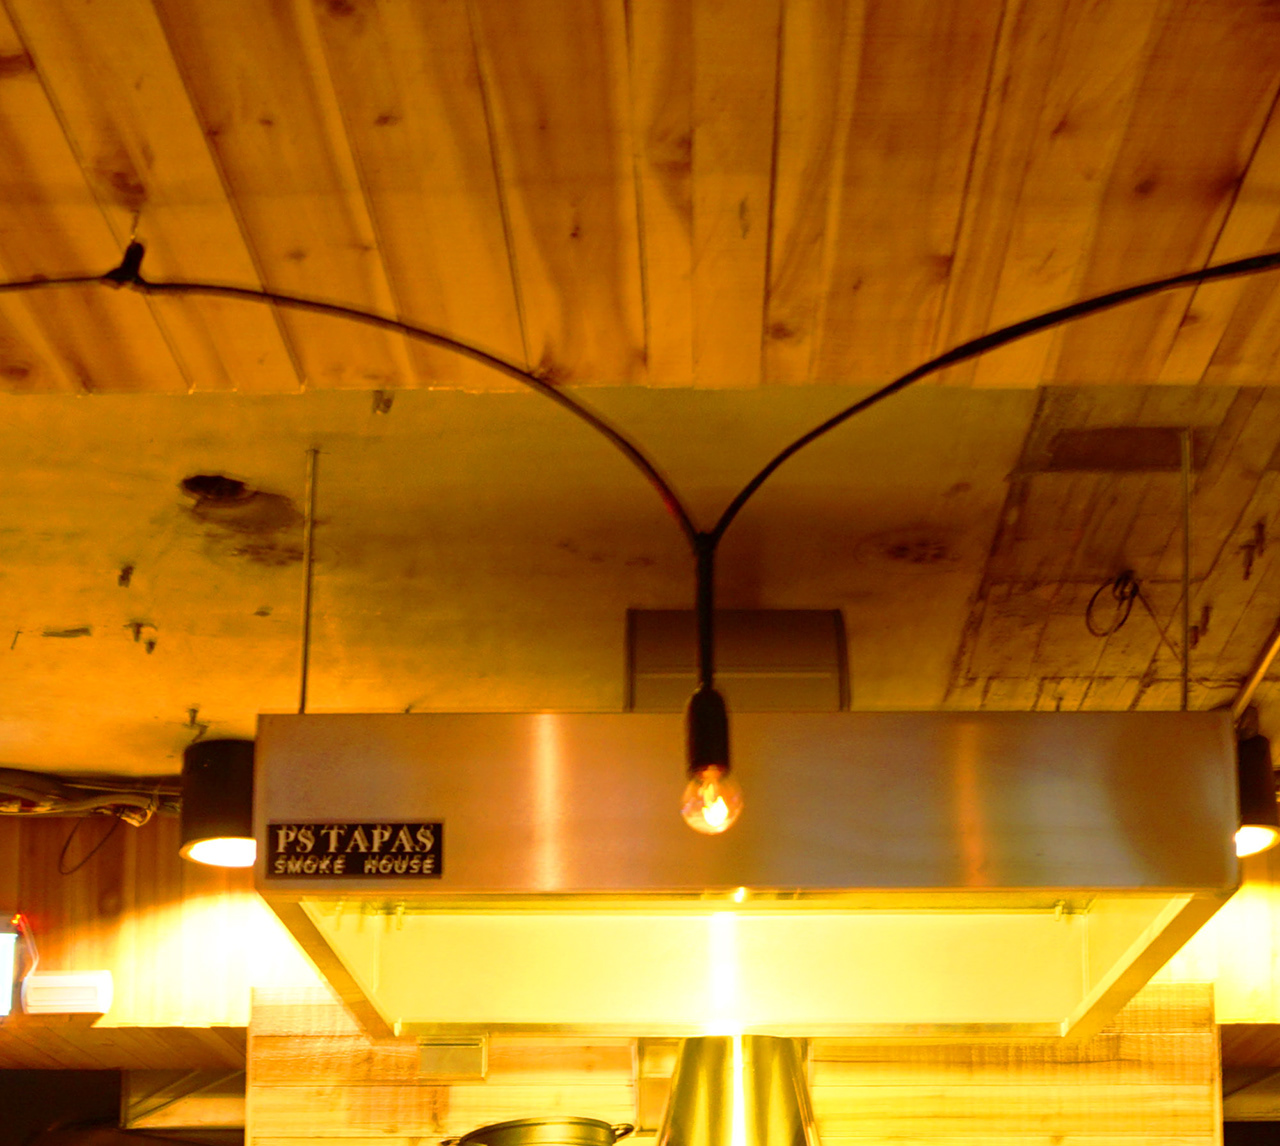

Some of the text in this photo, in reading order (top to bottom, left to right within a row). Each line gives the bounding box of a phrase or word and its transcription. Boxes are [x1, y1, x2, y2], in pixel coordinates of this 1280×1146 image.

[275, 825, 435, 853] PS TAPAS
[274, 855, 435, 875] SMOKE HOUSE
